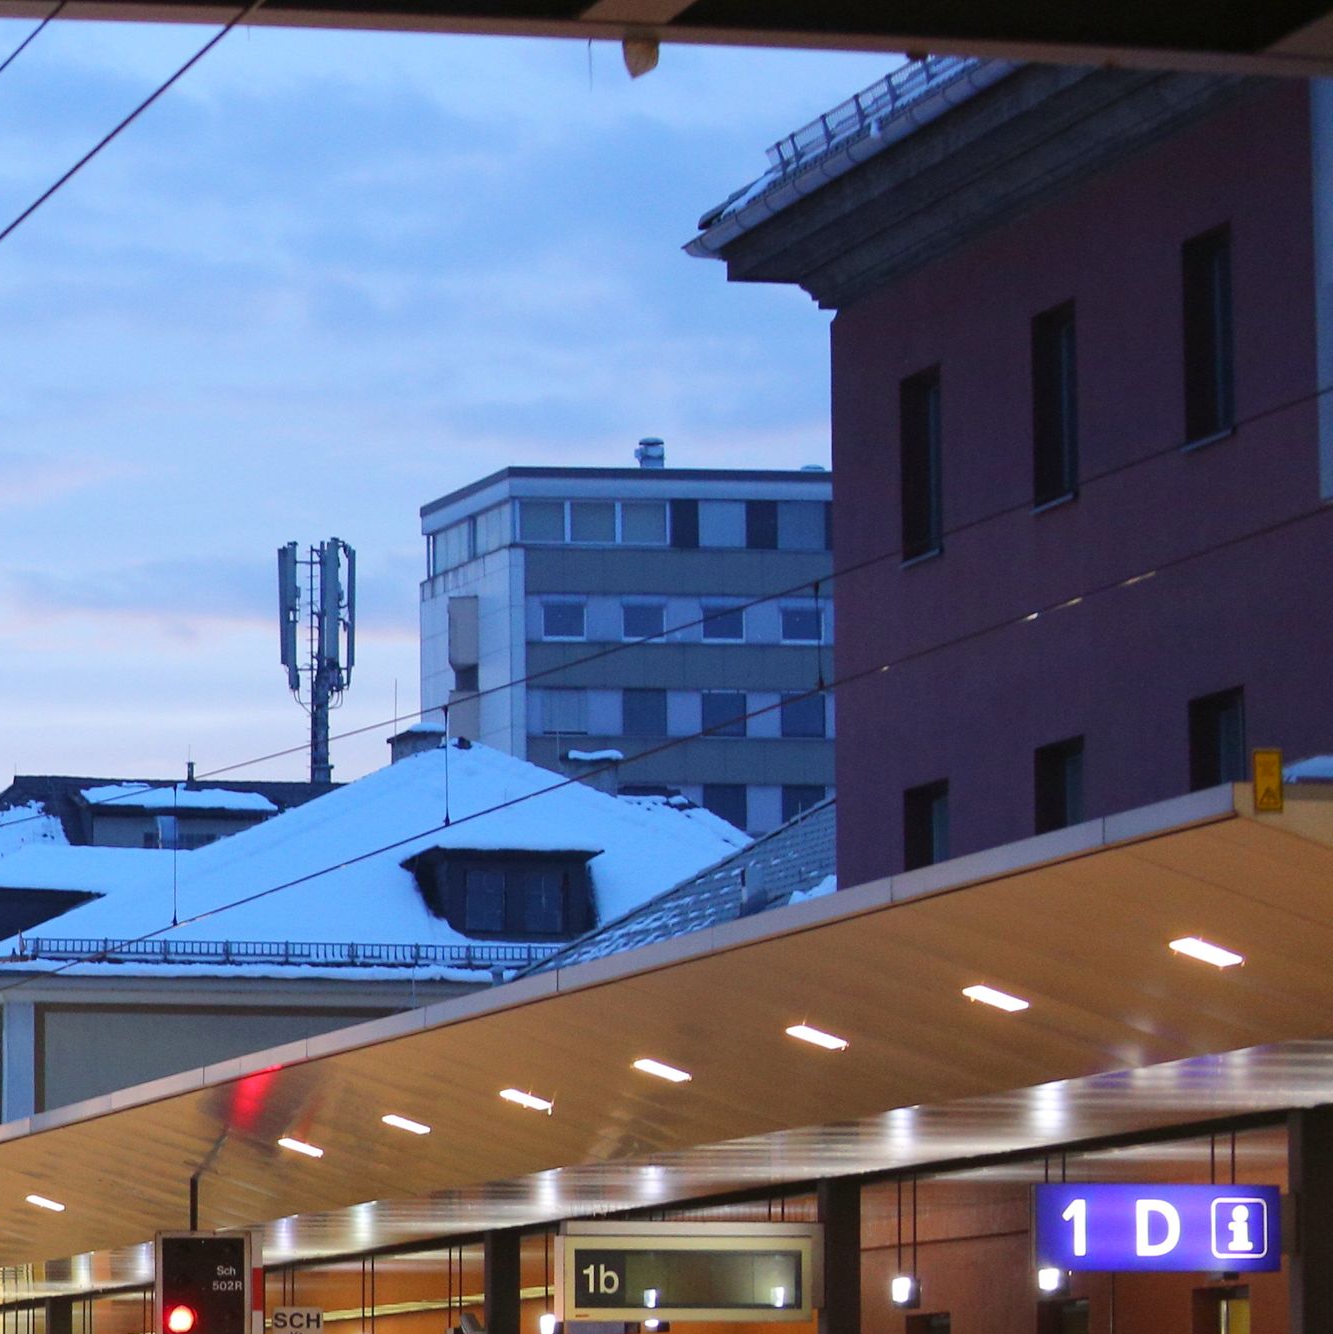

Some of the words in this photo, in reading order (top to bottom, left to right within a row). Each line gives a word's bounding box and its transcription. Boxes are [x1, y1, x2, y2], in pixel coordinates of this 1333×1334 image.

[1062, 1199, 1087, 1256] 1
[1135, 1199, 1181, 1256] D
[217, 1265, 236, 1276] Sch
[582, 1263, 619, 1294] 1b
[213, 1280, 243, 1291] 502R
[274, 1312, 321, 1329] SCH
